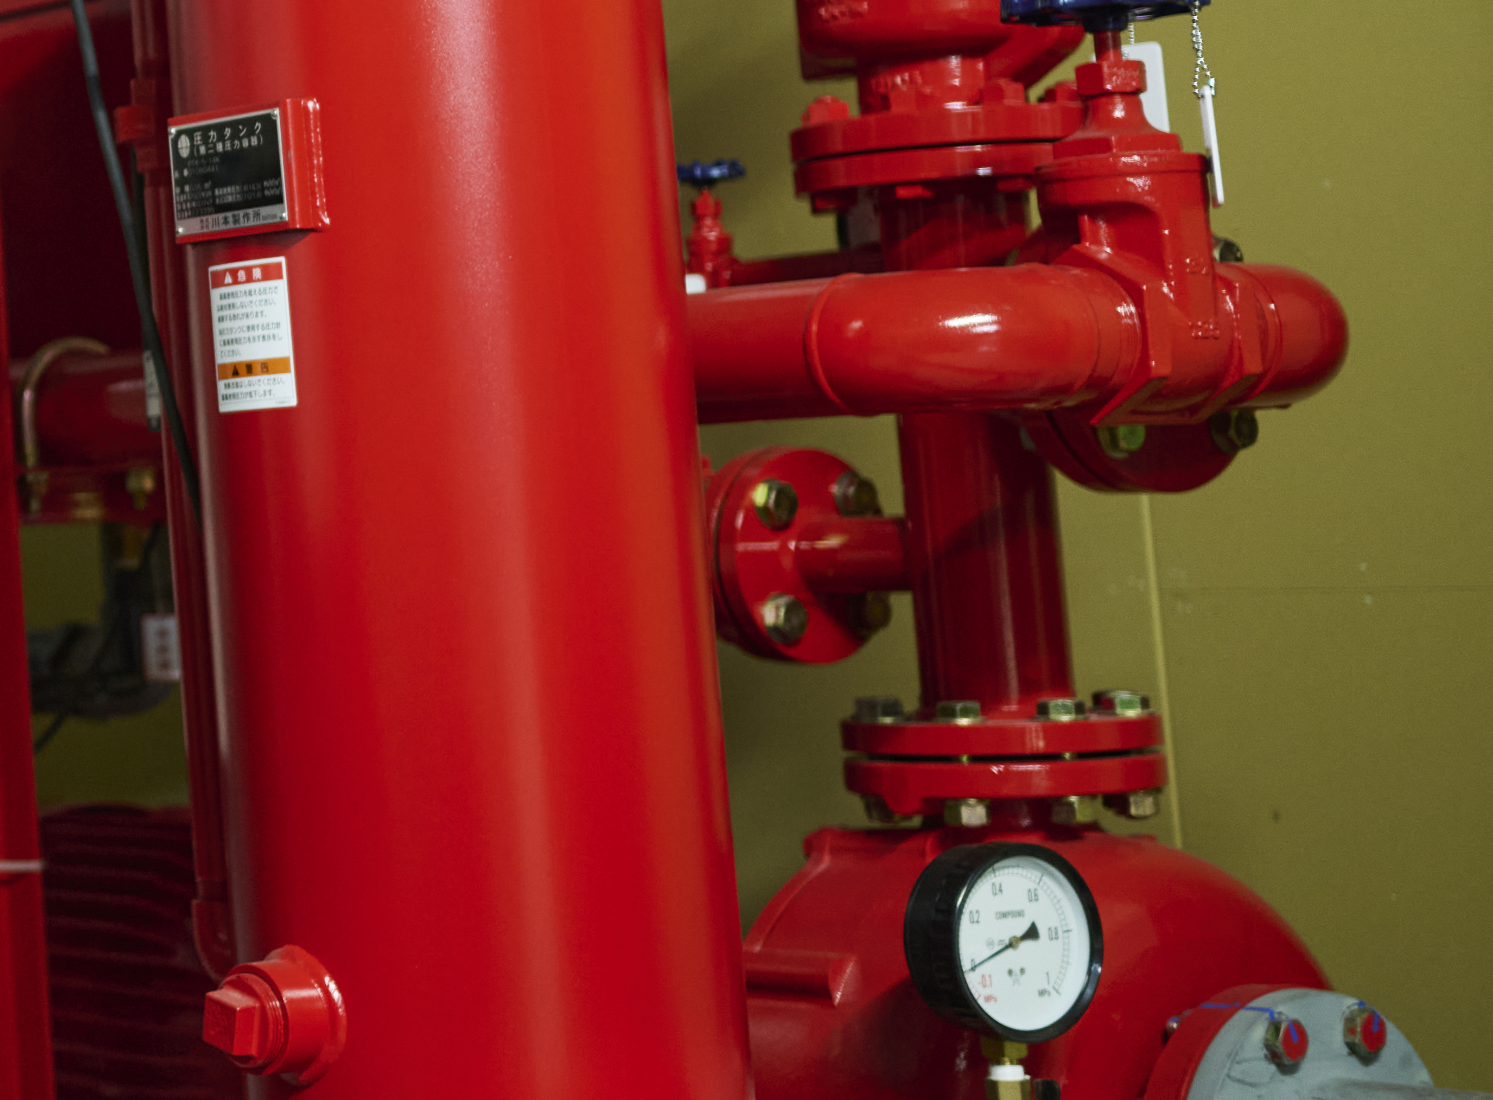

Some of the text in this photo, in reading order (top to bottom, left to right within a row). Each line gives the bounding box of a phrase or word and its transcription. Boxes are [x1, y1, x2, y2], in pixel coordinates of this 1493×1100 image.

[193, 121, 262, 145] 圧力タンク
[237, 267, 262, 282] 危険
[992, 882, 1003, 896] 0.4
[1027, 888, 1039, 902] 0.6
[969, 910, 980, 924] 0.2
[1048, 927, 1059, 941] 0.8
[979, 974, 993, 988] -0.1
[1046, 971, 1050, 985] 1
